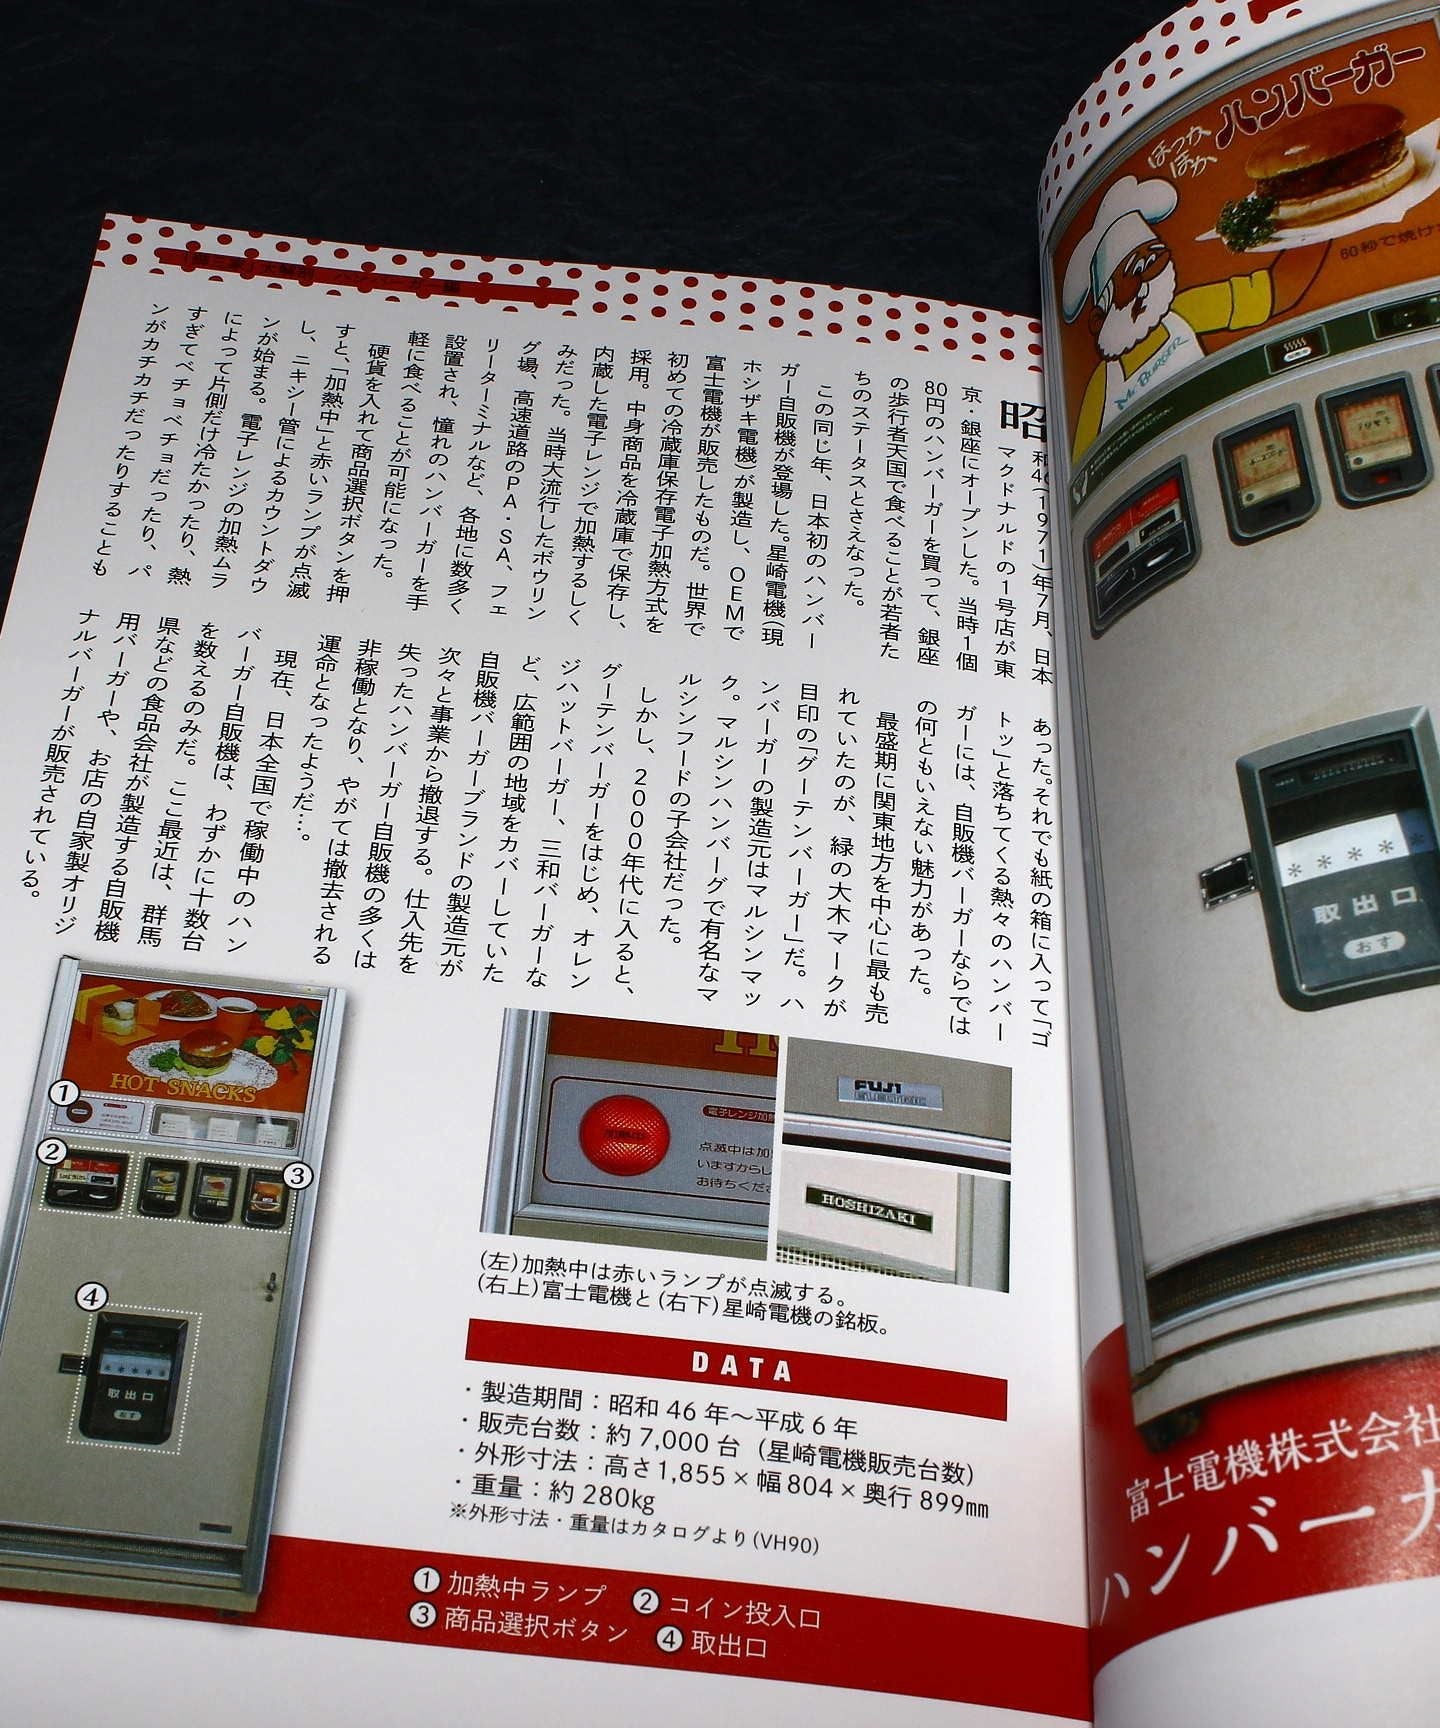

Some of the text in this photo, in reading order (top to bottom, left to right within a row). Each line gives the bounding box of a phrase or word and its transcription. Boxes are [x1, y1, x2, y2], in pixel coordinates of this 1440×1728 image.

[1215, 43, 1426, 150] ハンバーガー
[1312, 886, 1417, 924] 取出口
[110, 1072, 258, 1103] HOT SNACKS
[854, 1079, 902, 1094] FUJI
[698, 1141, 774, 1159] 点滅中は加
[821, 1193, 916, 1226] HOSHIZAKI
[692, 1349, 792, 1384] DATA
[1125, 1402, 1440, 1522] 富士電機株式会社
[447, 1570, 607, 1607] 加熱中ランプ
[669, 1593, 822, 1630] コイン投入口
[444, 1605, 630, 1643] 商品選択ボタン
[690, 1629, 768, 1659] 取出口
